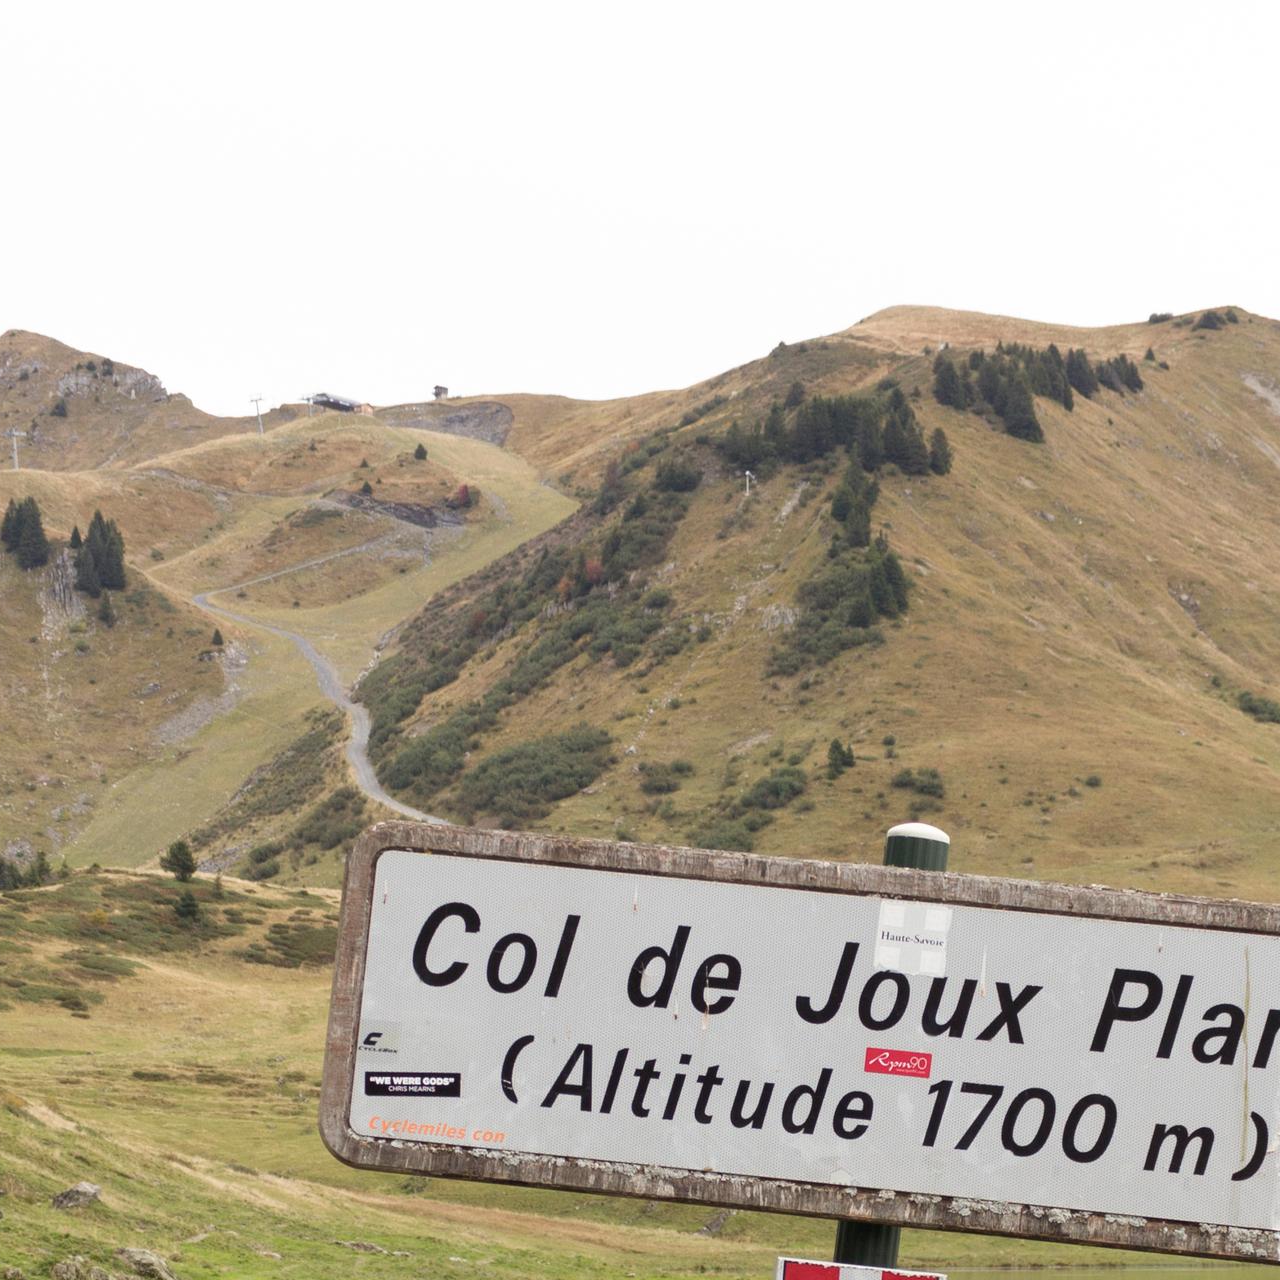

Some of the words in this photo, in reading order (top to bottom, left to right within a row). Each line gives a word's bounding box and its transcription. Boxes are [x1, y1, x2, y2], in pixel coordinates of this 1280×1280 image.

[881, 930, 944, 947] Haute-Savoie
[412, 902, 581, 994] Col
[627, 925, 742, 1015] de
[795, 941, 1044, 1045] Joux
[392, 1076, 421, 1086] WERE
[922, 1079, 1118, 1164] 1700
